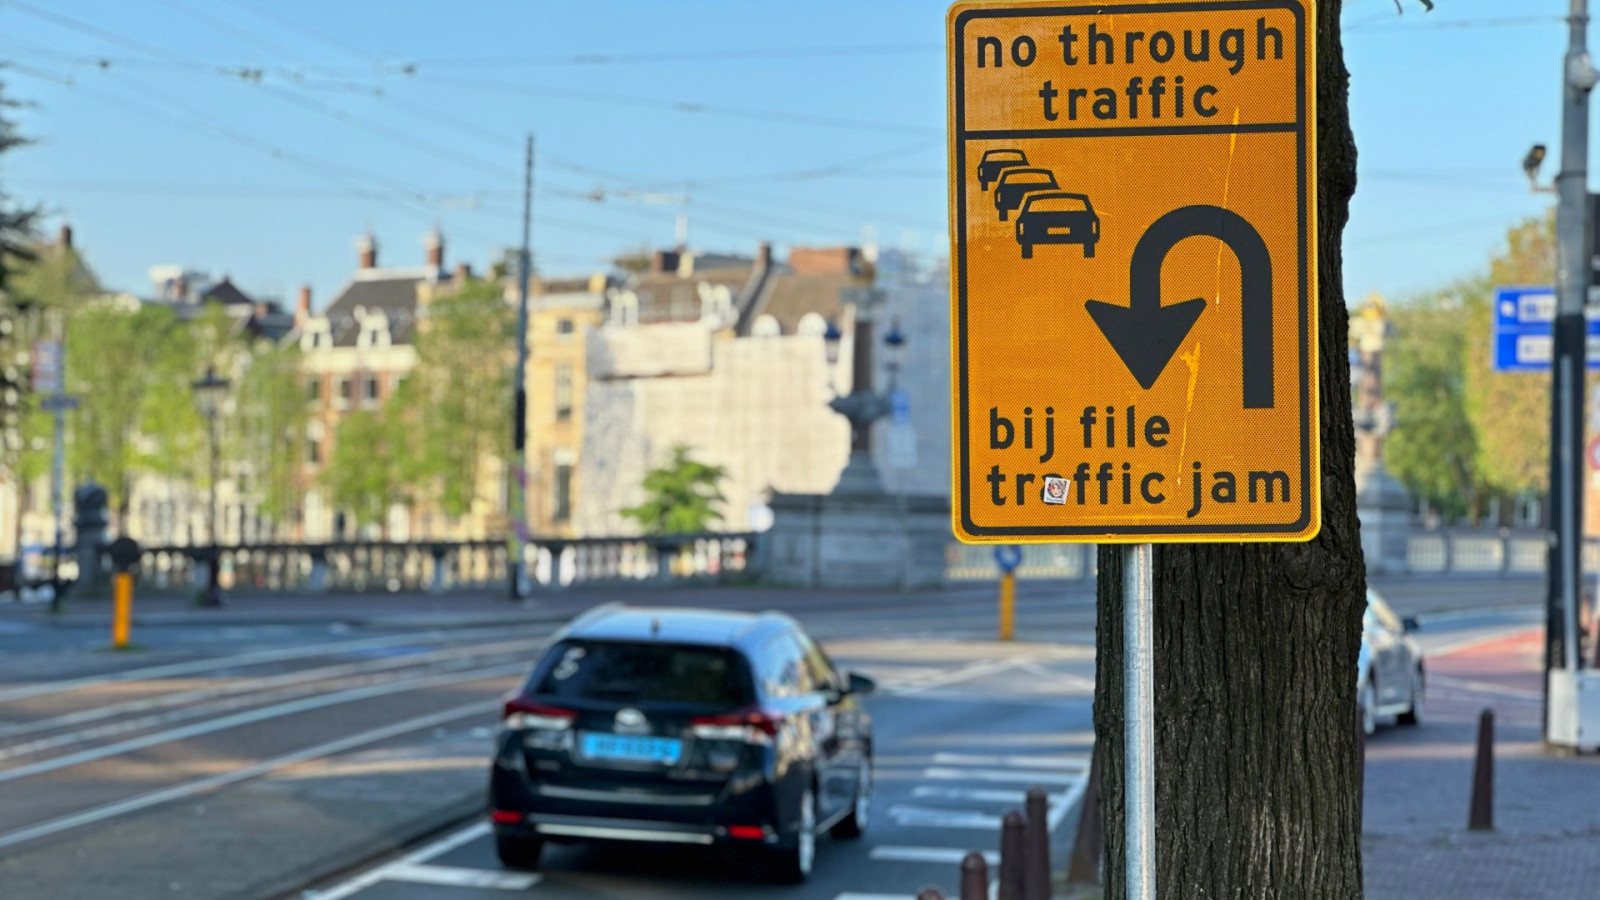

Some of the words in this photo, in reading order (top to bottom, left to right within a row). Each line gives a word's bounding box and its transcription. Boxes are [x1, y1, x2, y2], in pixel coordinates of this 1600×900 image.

[976, 35, 1037, 69] no
[1057, 16, 1284, 76] through
[1038, 75, 1219, 122] traffic
[989, 406, 1055, 464] bij
[1079, 405, 1171, 449] file
[986, 461, 1166, 507] trffic
[1186, 461, 1291, 519] jam
